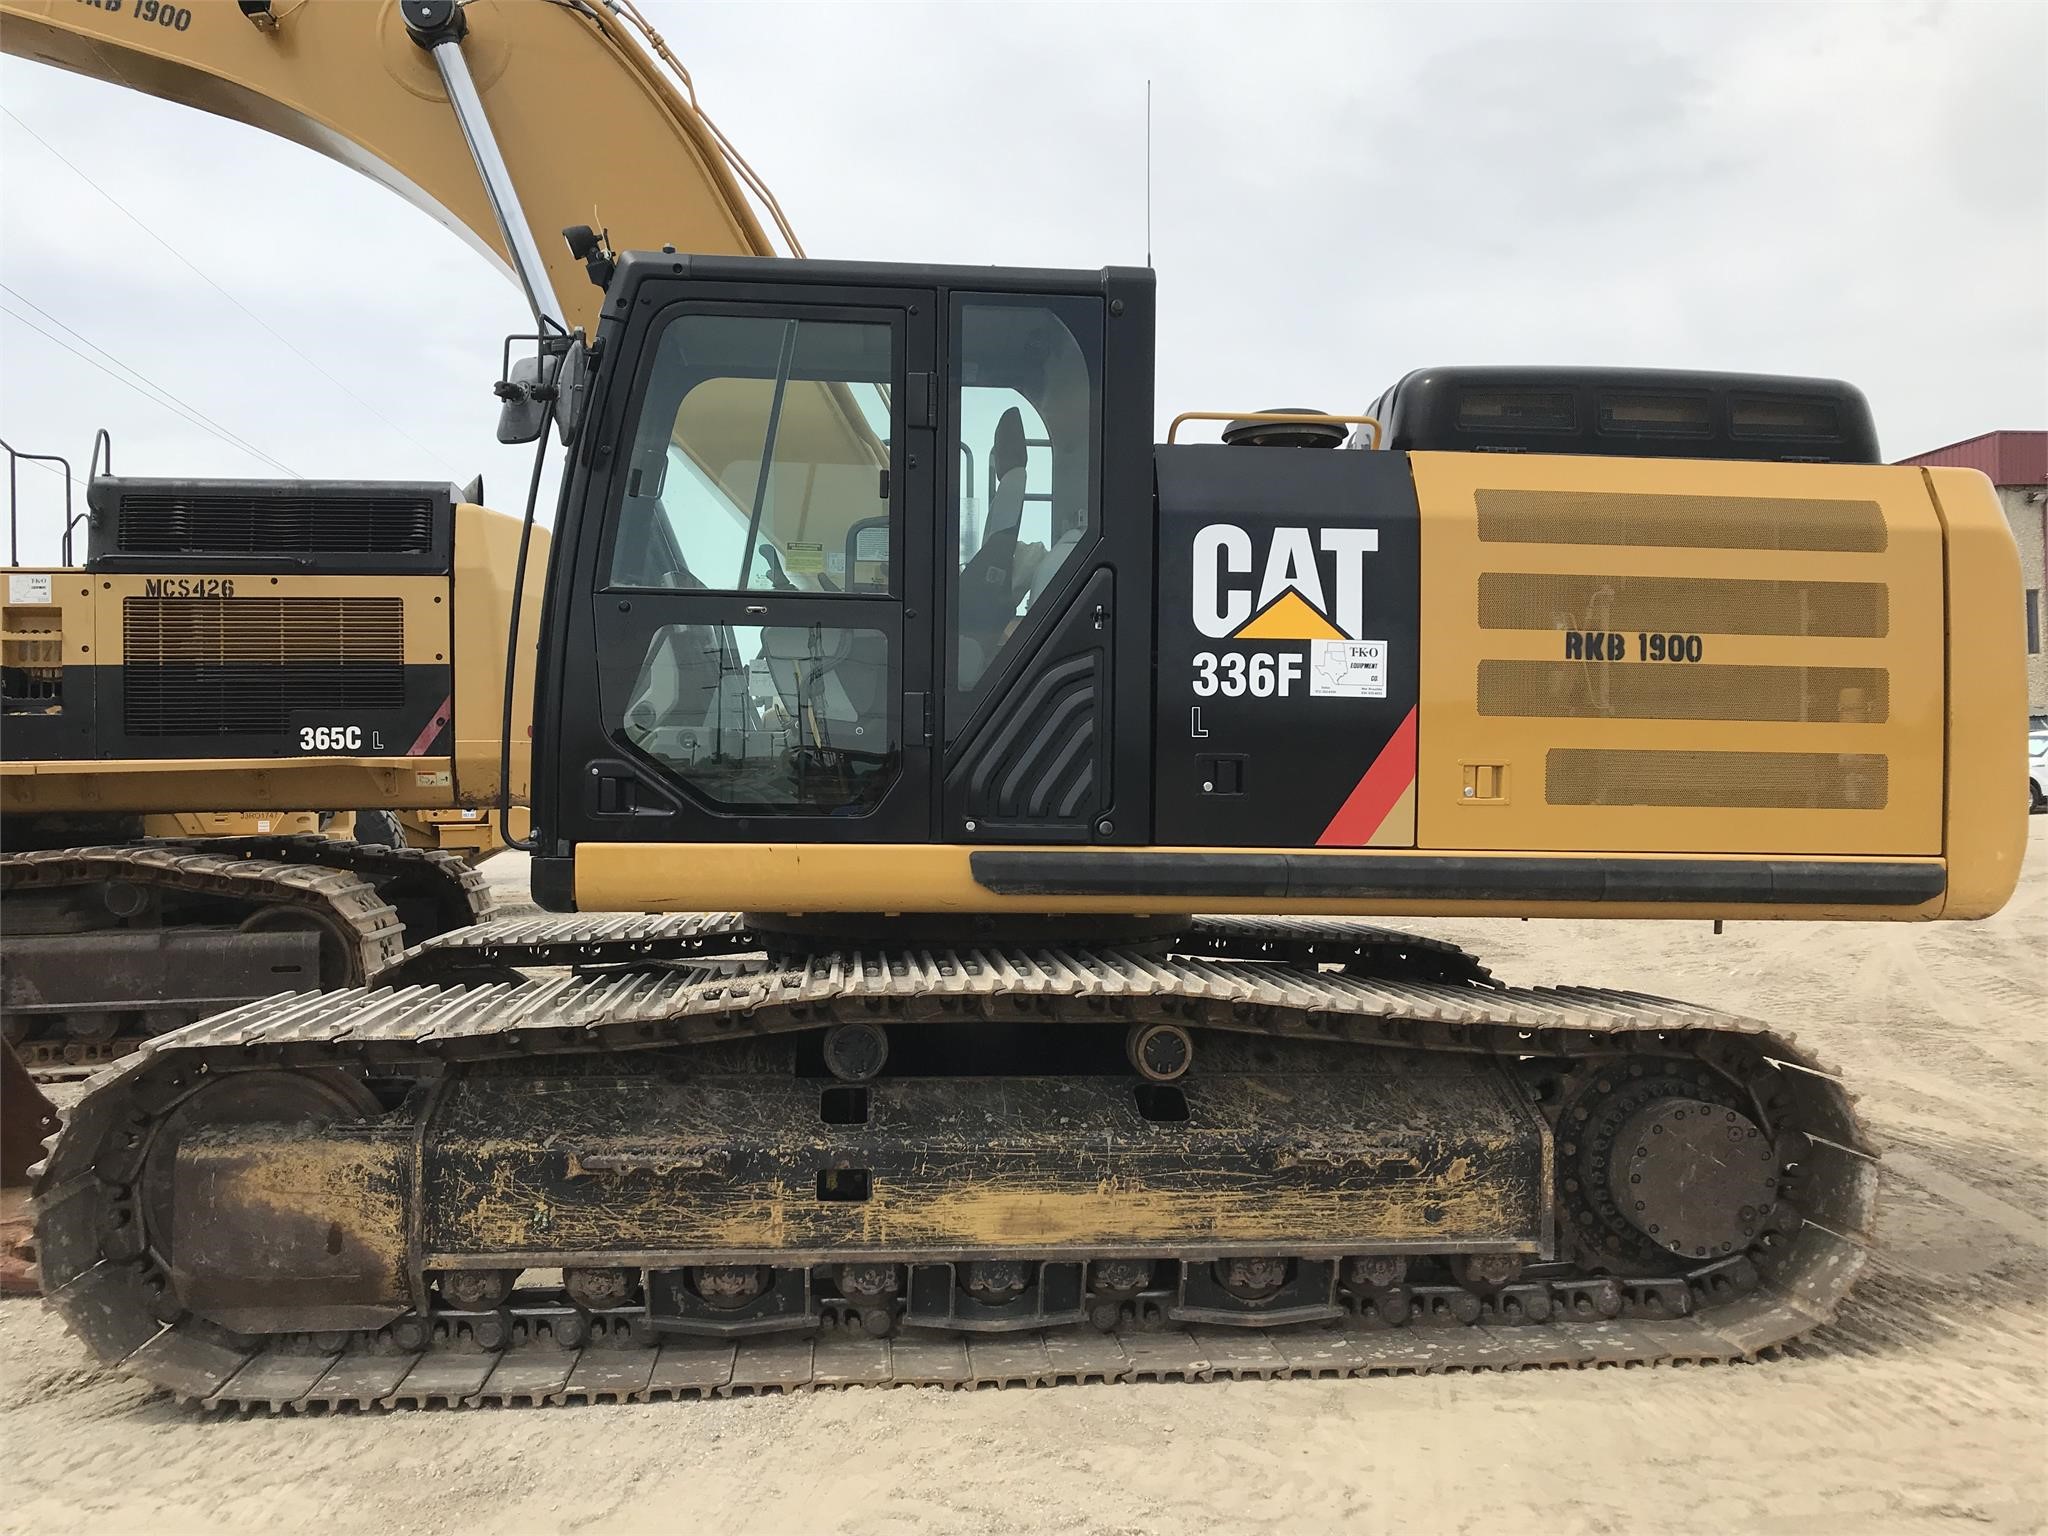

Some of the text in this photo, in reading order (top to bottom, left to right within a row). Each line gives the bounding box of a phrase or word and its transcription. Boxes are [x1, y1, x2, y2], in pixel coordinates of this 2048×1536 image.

[133, 0, 192, 31] 1900
[145, 578, 234, 599] MCS426
[1192, 523, 1379, 640] CAT
[1565, 631, 1703, 663] RKB 1900
[1192, 652, 1303, 698] 336F
[300, 726, 384, 750] 365C L
[1191, 706, 1209, 738] L
